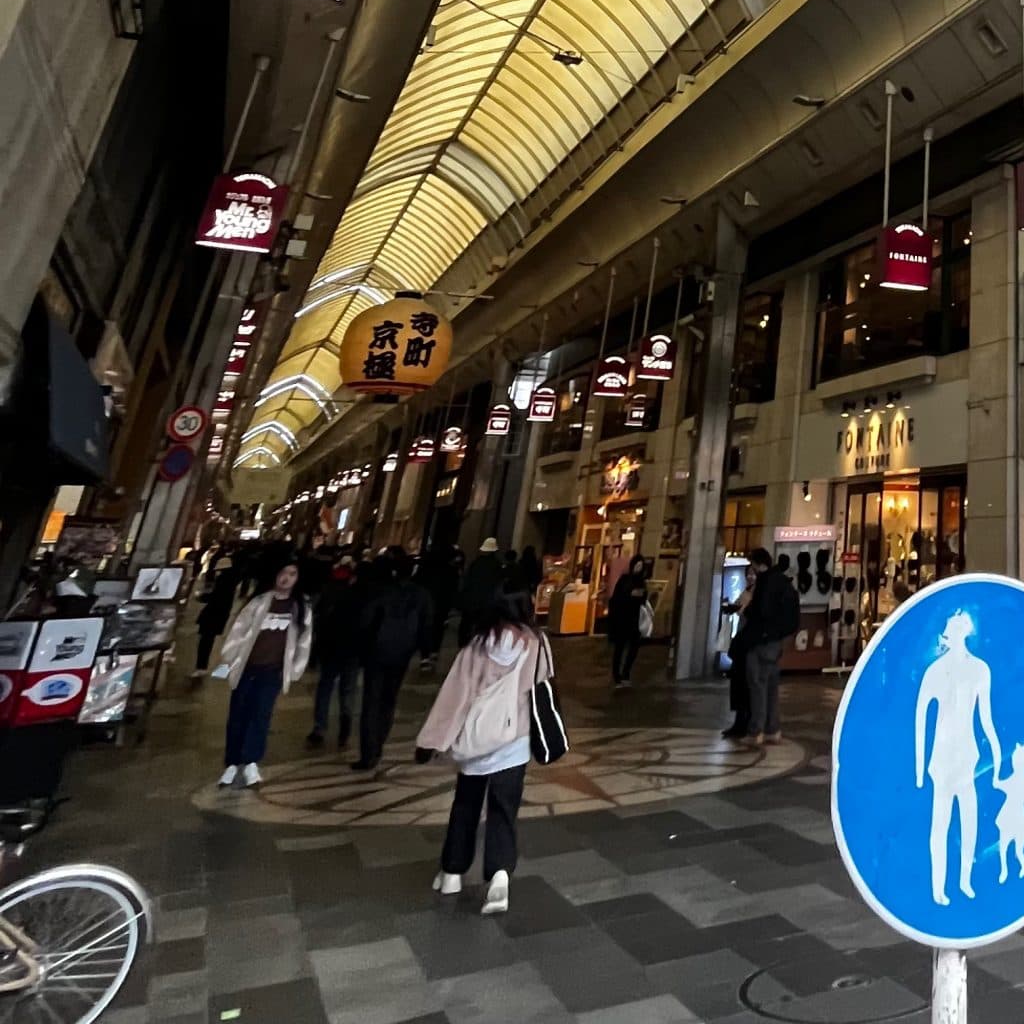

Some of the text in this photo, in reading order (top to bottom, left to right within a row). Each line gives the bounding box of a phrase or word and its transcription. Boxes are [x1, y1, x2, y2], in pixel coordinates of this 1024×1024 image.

[362, 320, 403, 381] 京極
[402, 311, 440, 369] 寺町
[176, 415, 198, 430] 30
[836, 417, 915, 454] FONTAINE
